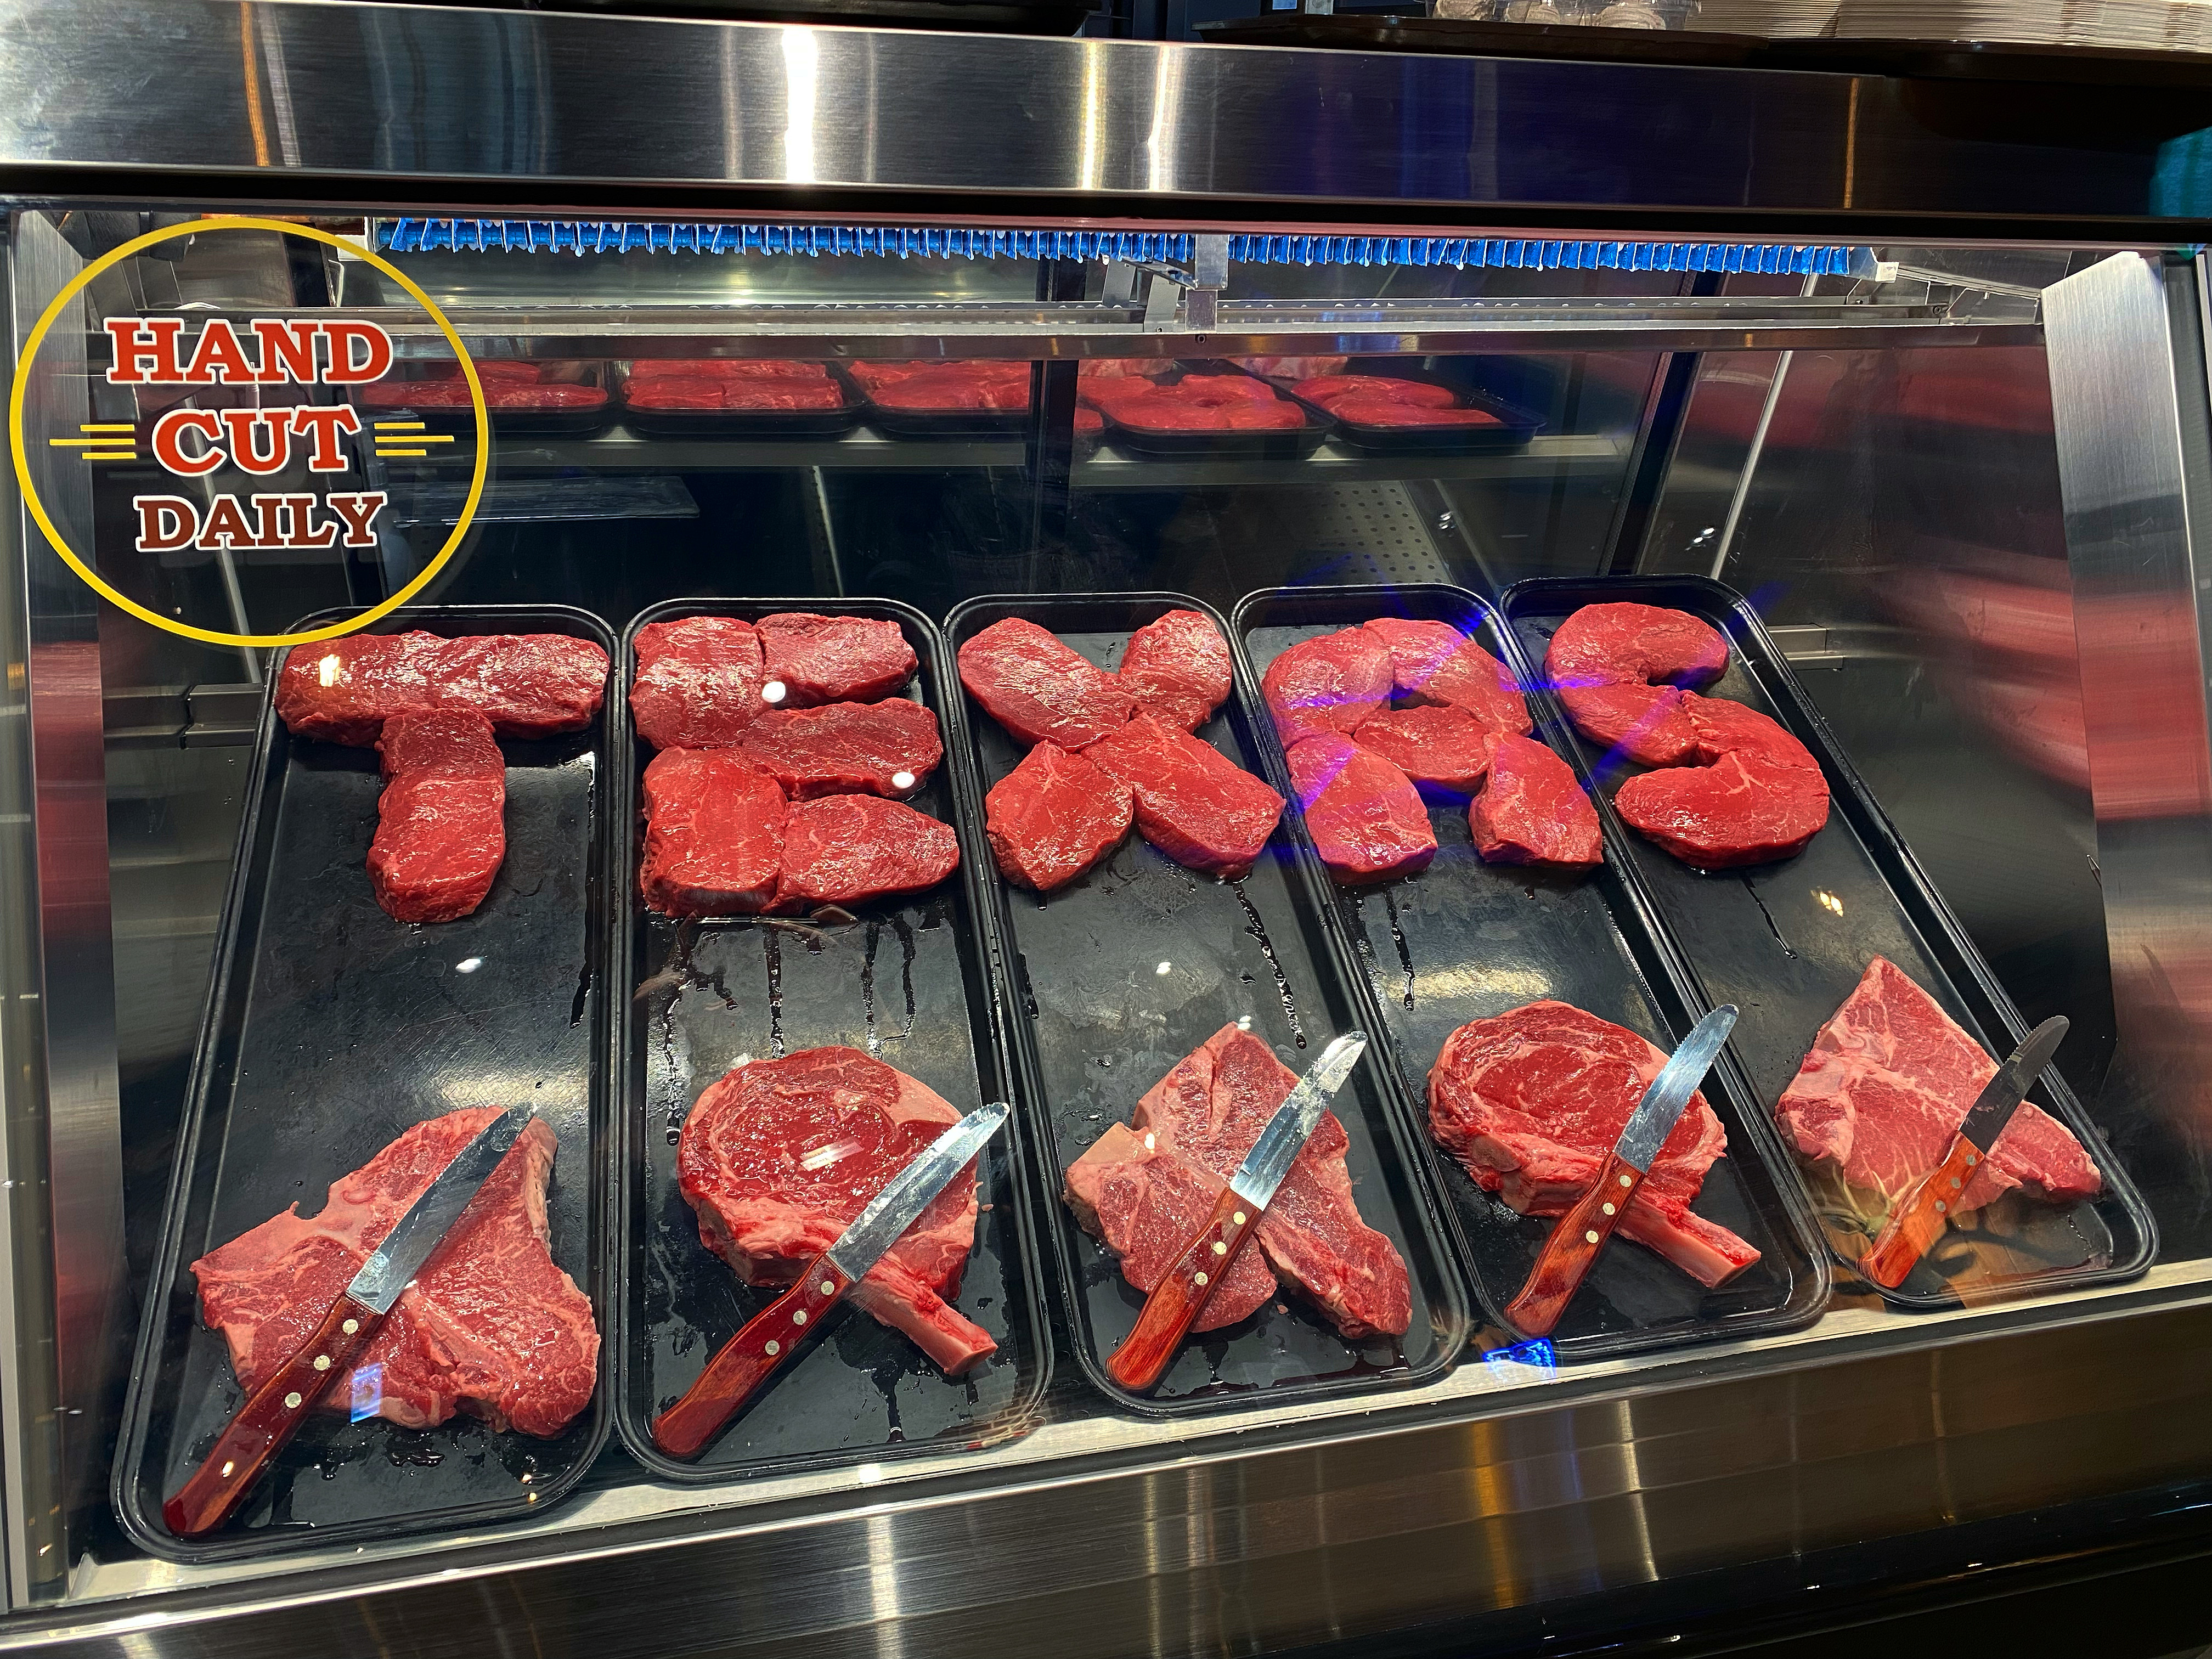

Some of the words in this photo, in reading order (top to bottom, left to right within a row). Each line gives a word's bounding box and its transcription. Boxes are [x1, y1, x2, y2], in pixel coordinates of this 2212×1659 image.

[104, 317, 393, 385] HAND
[151, 404, 362, 476] CUT
[133, 492, 387, 553] DAILY
[274, 602, 1831, 923] TEXAS
